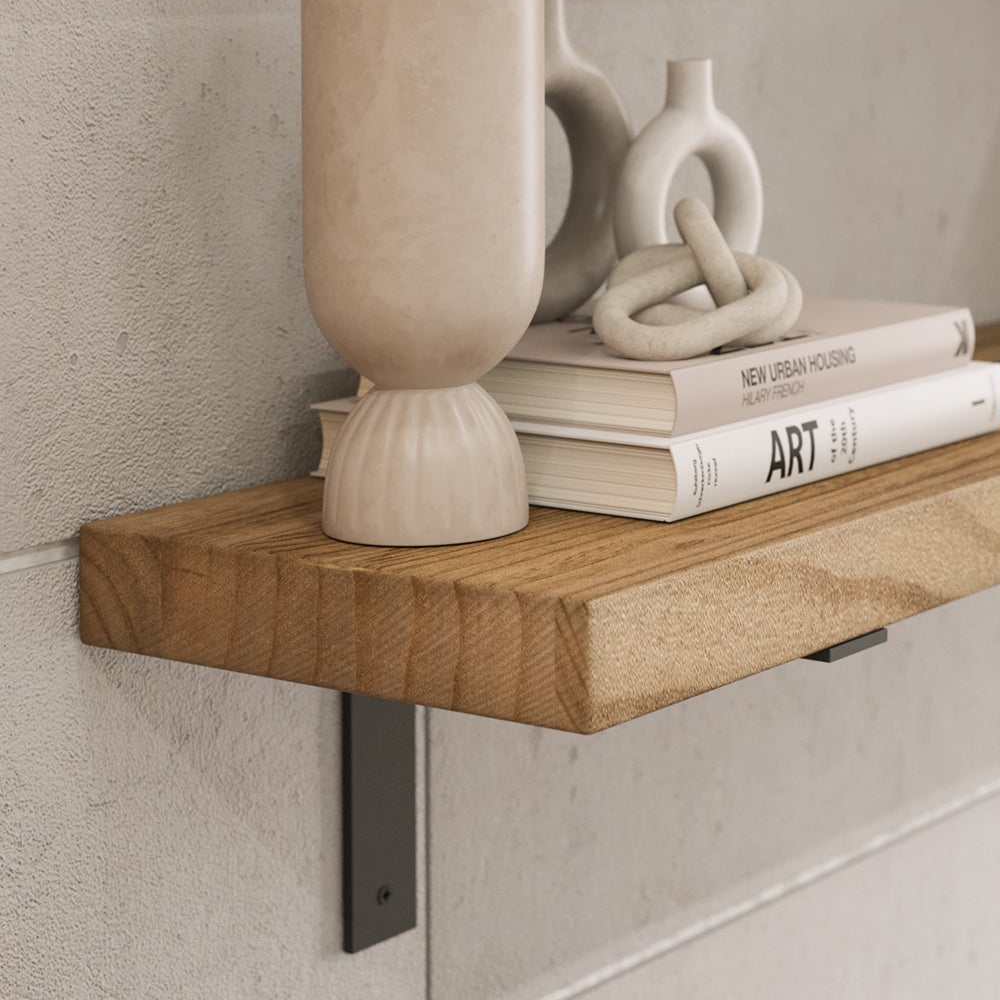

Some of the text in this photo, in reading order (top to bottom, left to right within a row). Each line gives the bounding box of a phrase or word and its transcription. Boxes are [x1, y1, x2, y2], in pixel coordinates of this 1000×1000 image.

[741, 346, 857, 388] NEW URBAN HOUSING
[742, 380, 805, 408] HILARY FRENCH
[765, 419, 819, 483] ART
